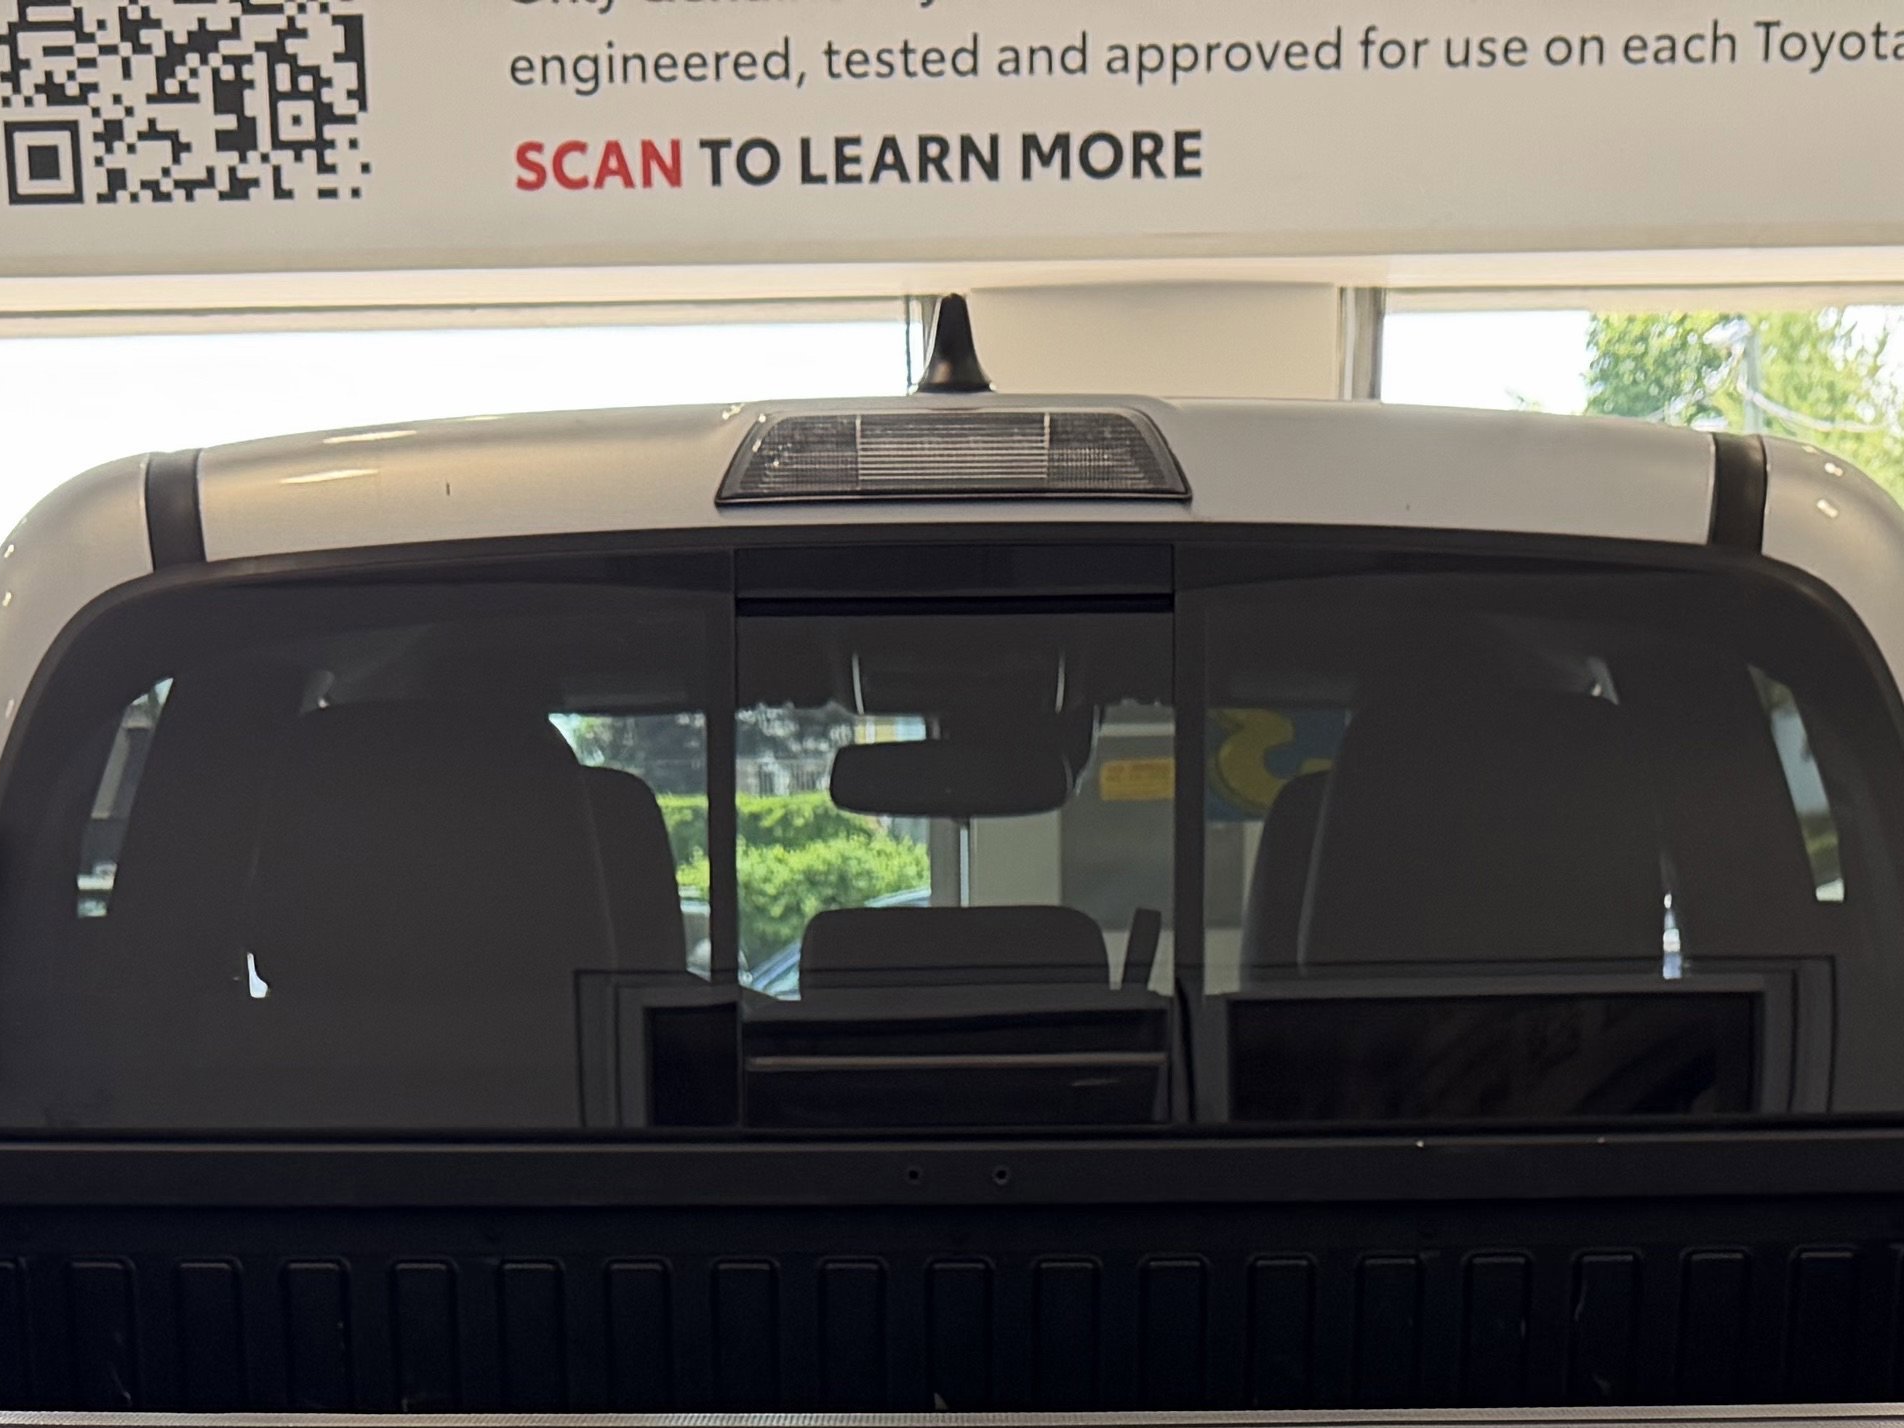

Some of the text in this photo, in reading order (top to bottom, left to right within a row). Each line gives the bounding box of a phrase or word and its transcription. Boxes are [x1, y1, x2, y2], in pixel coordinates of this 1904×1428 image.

[509, 35, 806, 96] engineered,
[822, 31, 980, 80] tested
[996, 30, 1089, 78] and
[1105, 27, 1343, 85] approved
[1358, 25, 1430, 70] for
[1444, 32, 1529, 69] use
[1544, 31, 1607, 67] on
[1622, 20, 1737, 66] each
[514, 129, 1203, 191] SCAN TO LEARN MORE
